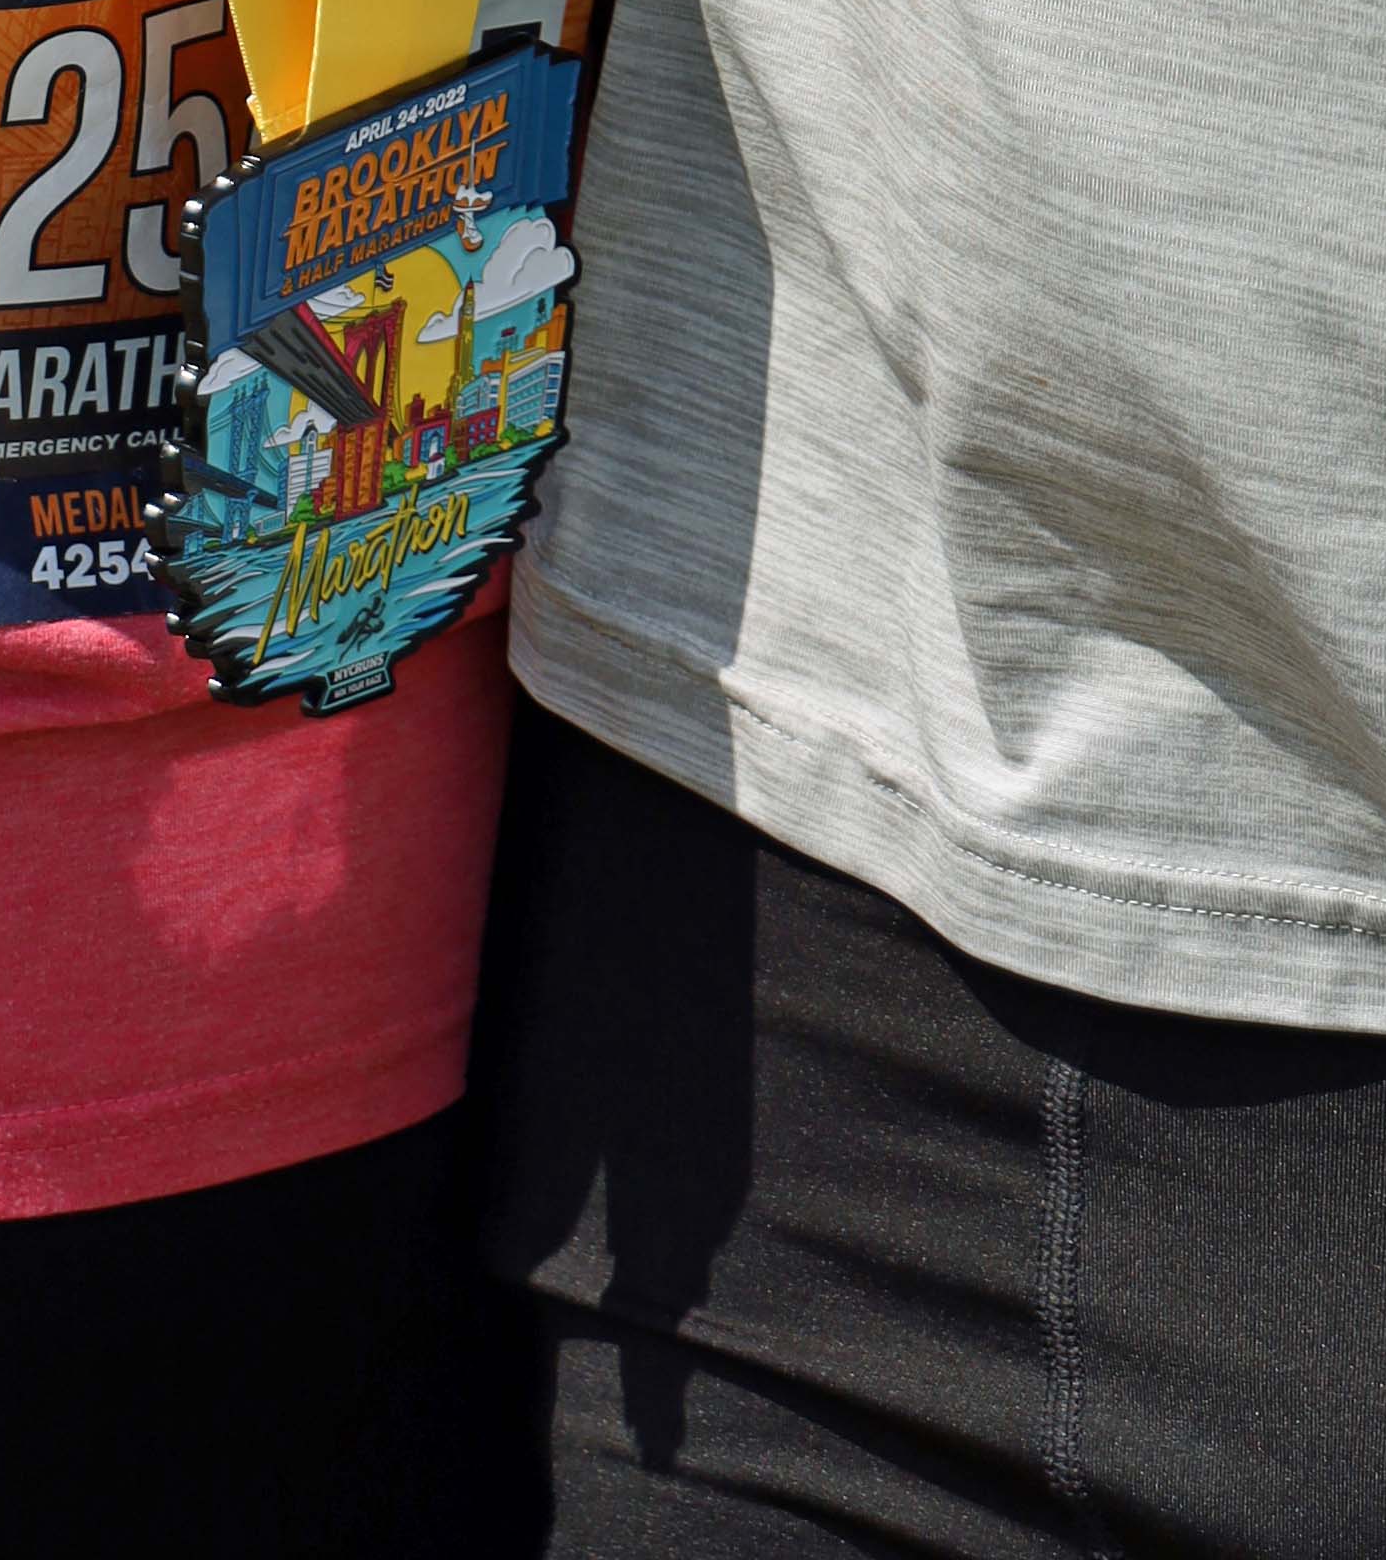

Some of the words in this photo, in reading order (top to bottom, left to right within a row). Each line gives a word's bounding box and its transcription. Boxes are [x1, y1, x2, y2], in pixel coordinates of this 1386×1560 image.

[288, 92, 510, 227] BROOKLYN
[344, 117, 396, 154] APRIL
[282, 140, 509, 271] MARATHON
[297, 253, 344, 290] HALF
[349, 203, 454, 267] MARATHON
[29, 486, 148, 538] MEDAL
[252, 482, 470, 666] Marathon
[332, 651, 386, 684] NYCRUNS
[348, 680, 364, 695] YOUR
[365, 673, 383, 690] RACE
